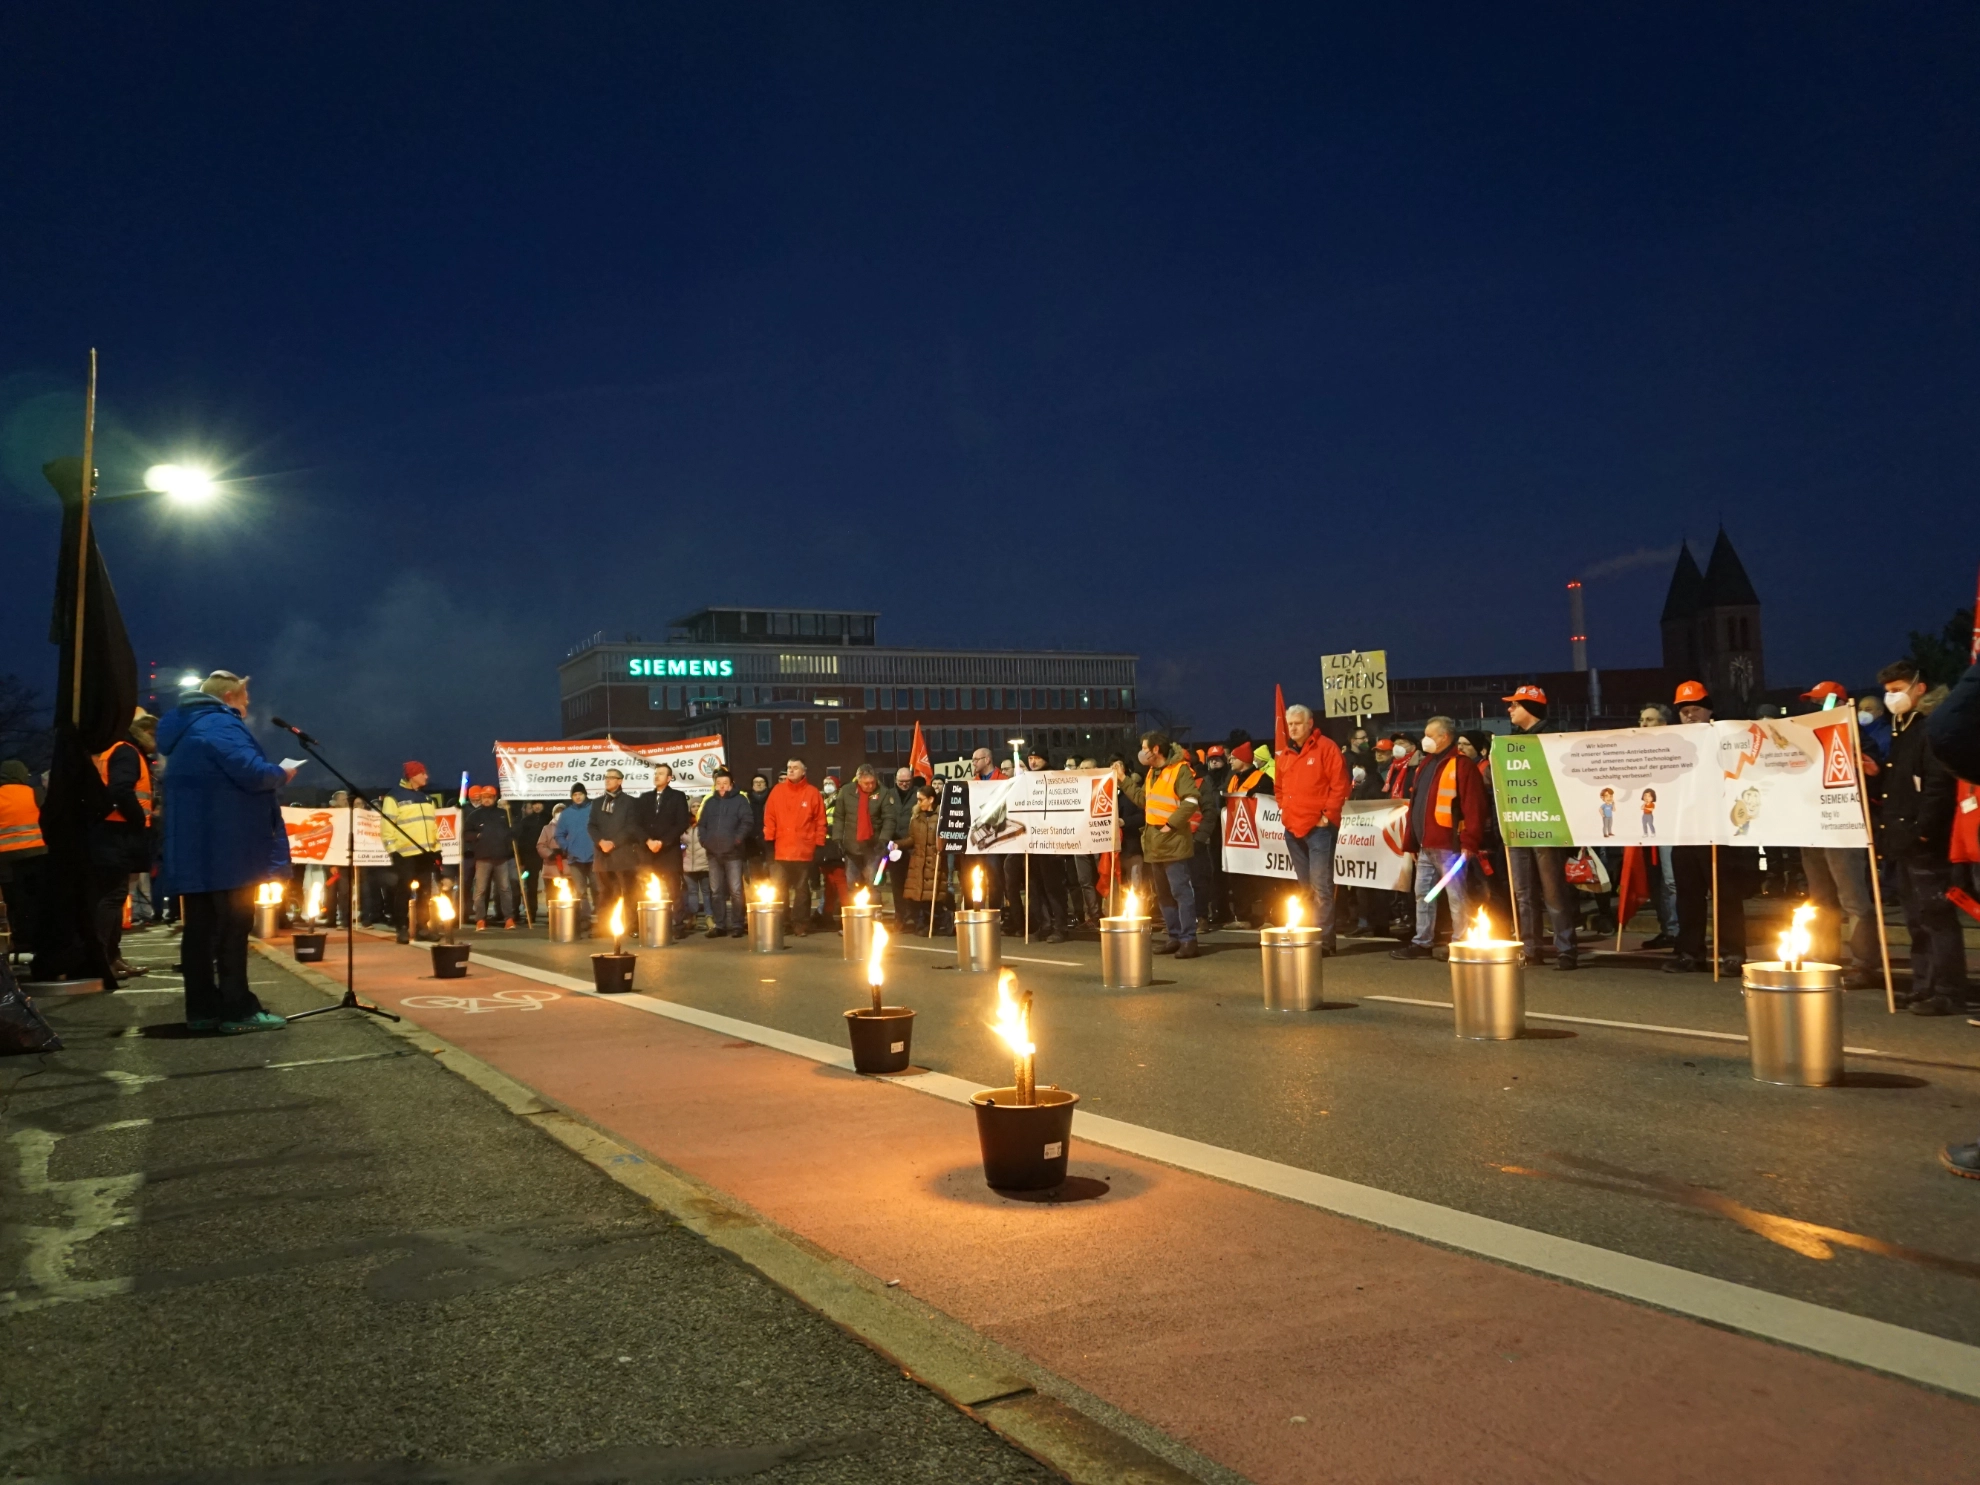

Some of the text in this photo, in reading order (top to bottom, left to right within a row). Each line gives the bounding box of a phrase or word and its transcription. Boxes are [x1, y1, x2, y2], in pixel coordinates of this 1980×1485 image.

[1331, 653, 1365, 669] LDA
[629, 658, 734, 677] SIEMENS
[1324, 671, 1385, 690] SIEMENS
[1334, 693, 1373, 715] NBG
[684, 742, 702, 750] wahr
[1507, 743, 1526, 753] Die
[1721, 739, 1751, 750] Ich was!
[1602, 747, 1670, 757] Siemens-Antriebstechnik
[524, 759, 564, 771] Gegen
[567, 758, 586, 768] die
[672, 758, 694, 768] des
[1506, 759, 1531, 771] LDA
[1609, 764, 1638, 772] Menschen
[944, 762, 974, 779] LDA
[526, 772, 578, 783] Siemens
[679, 772, 695, 781] Vo
[1047, 777, 1078, 785] ZERSCHLAGEN
[1507, 777, 1538, 787] muss
[952, 785, 962, 793] Die
[1507, 793, 1542, 804] in der
[1820, 793, 1849, 805] SIEMENS
[1821, 810, 1832, 820] Nbg
[955, 820, 964, 828] der
[1820, 821, 1866, 830] Vertrauensleute
[940, 831, 965, 840] SIEMENS
[1031, 826, 1075, 835] Dieser Standort
[1510, 829, 1553, 839] bleiben
[1039, 840, 1055, 849] nicht
[1056, 840, 1082, 850] sterben!
[1348, 834, 1375, 847] Metall
[1335, 855, 1377, 880] ÜRTH
